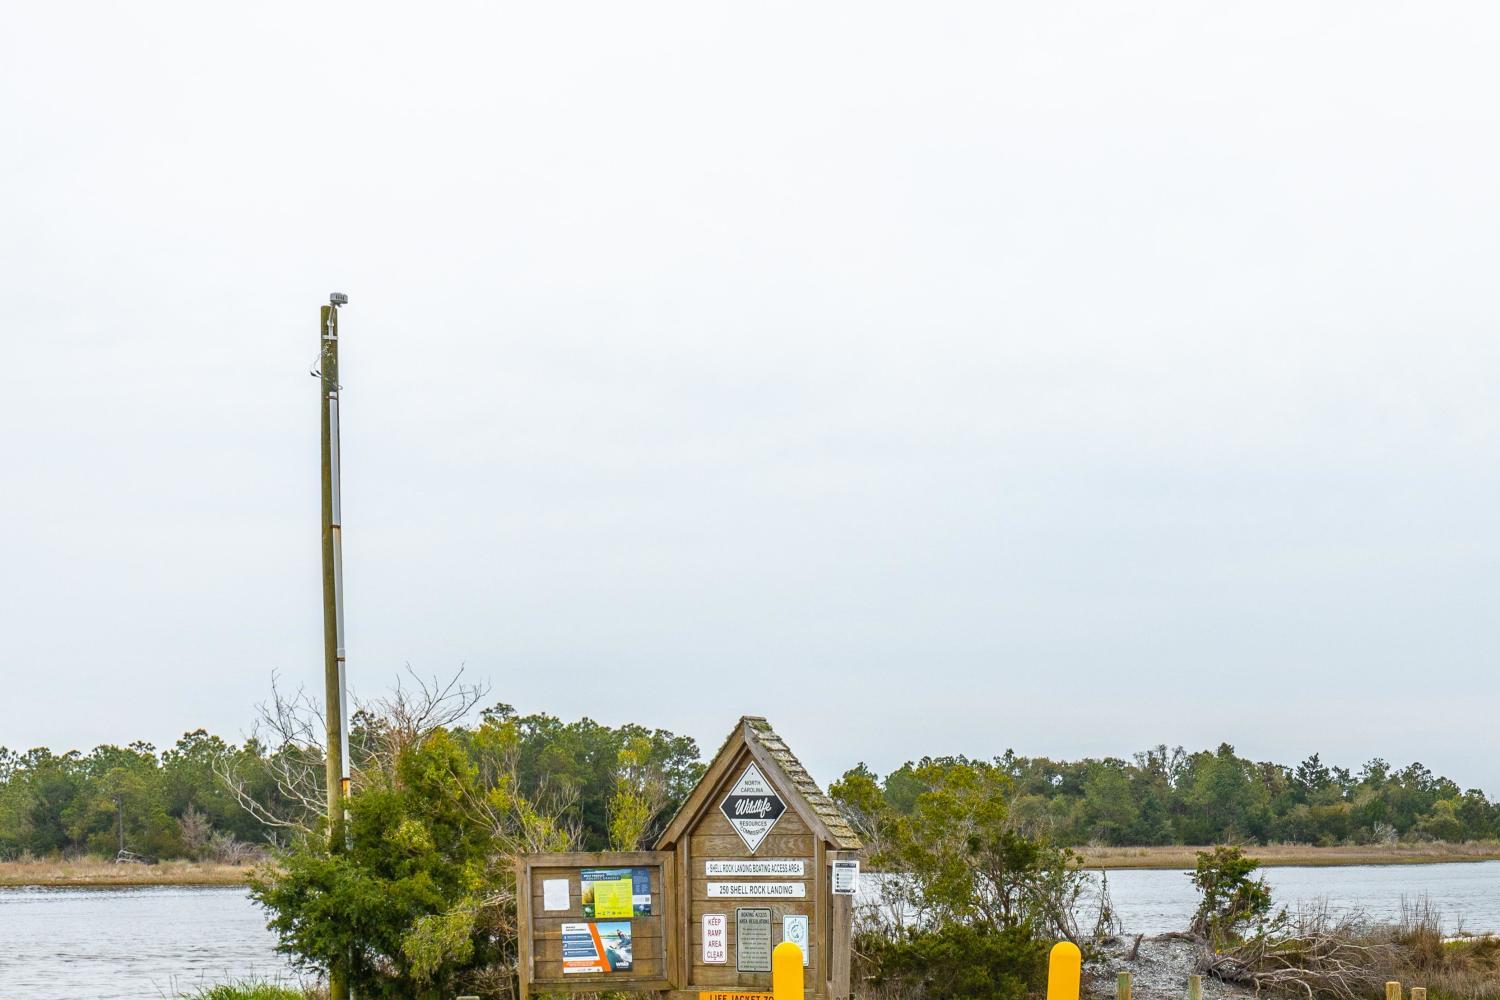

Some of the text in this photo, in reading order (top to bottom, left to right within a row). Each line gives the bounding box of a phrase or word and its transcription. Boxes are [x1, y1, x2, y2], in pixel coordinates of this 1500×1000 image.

[735, 797, 772, 818] Wildlife
[740, 827, 766, 835] COMMISSION
[710, 863, 800, 873] SHELL ROCK LANDING BOATING ACCESS AREA
[719, 885, 793, 895] 250 SHELL ROCK LANDING
[707, 929, 722, 937] RAMP
[708, 940, 722, 948] AREA
[707, 951, 723, 959] CLEAR
